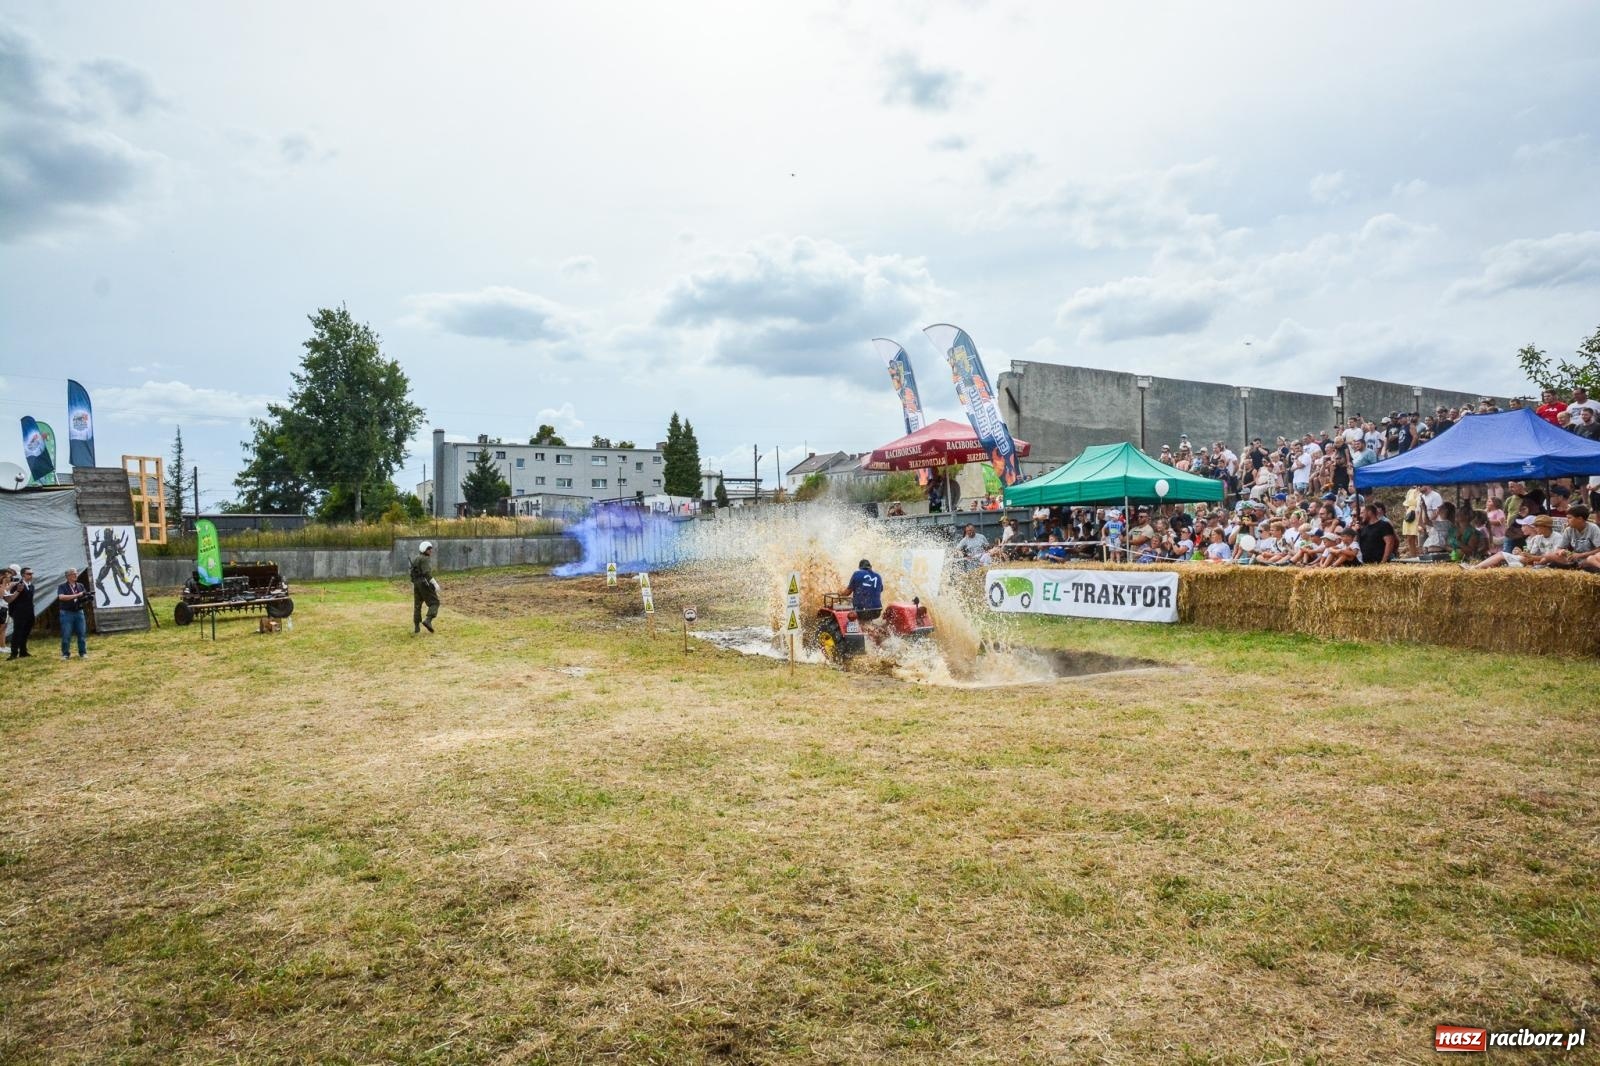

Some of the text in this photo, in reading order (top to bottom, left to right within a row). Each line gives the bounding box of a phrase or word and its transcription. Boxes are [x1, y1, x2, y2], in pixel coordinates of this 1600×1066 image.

[885, 444, 923, 460] RACIBORSKIE
[946, 440, 983, 451] RACIBORSK
[1042, 582, 1171, 608] EL-TRAKTOR
